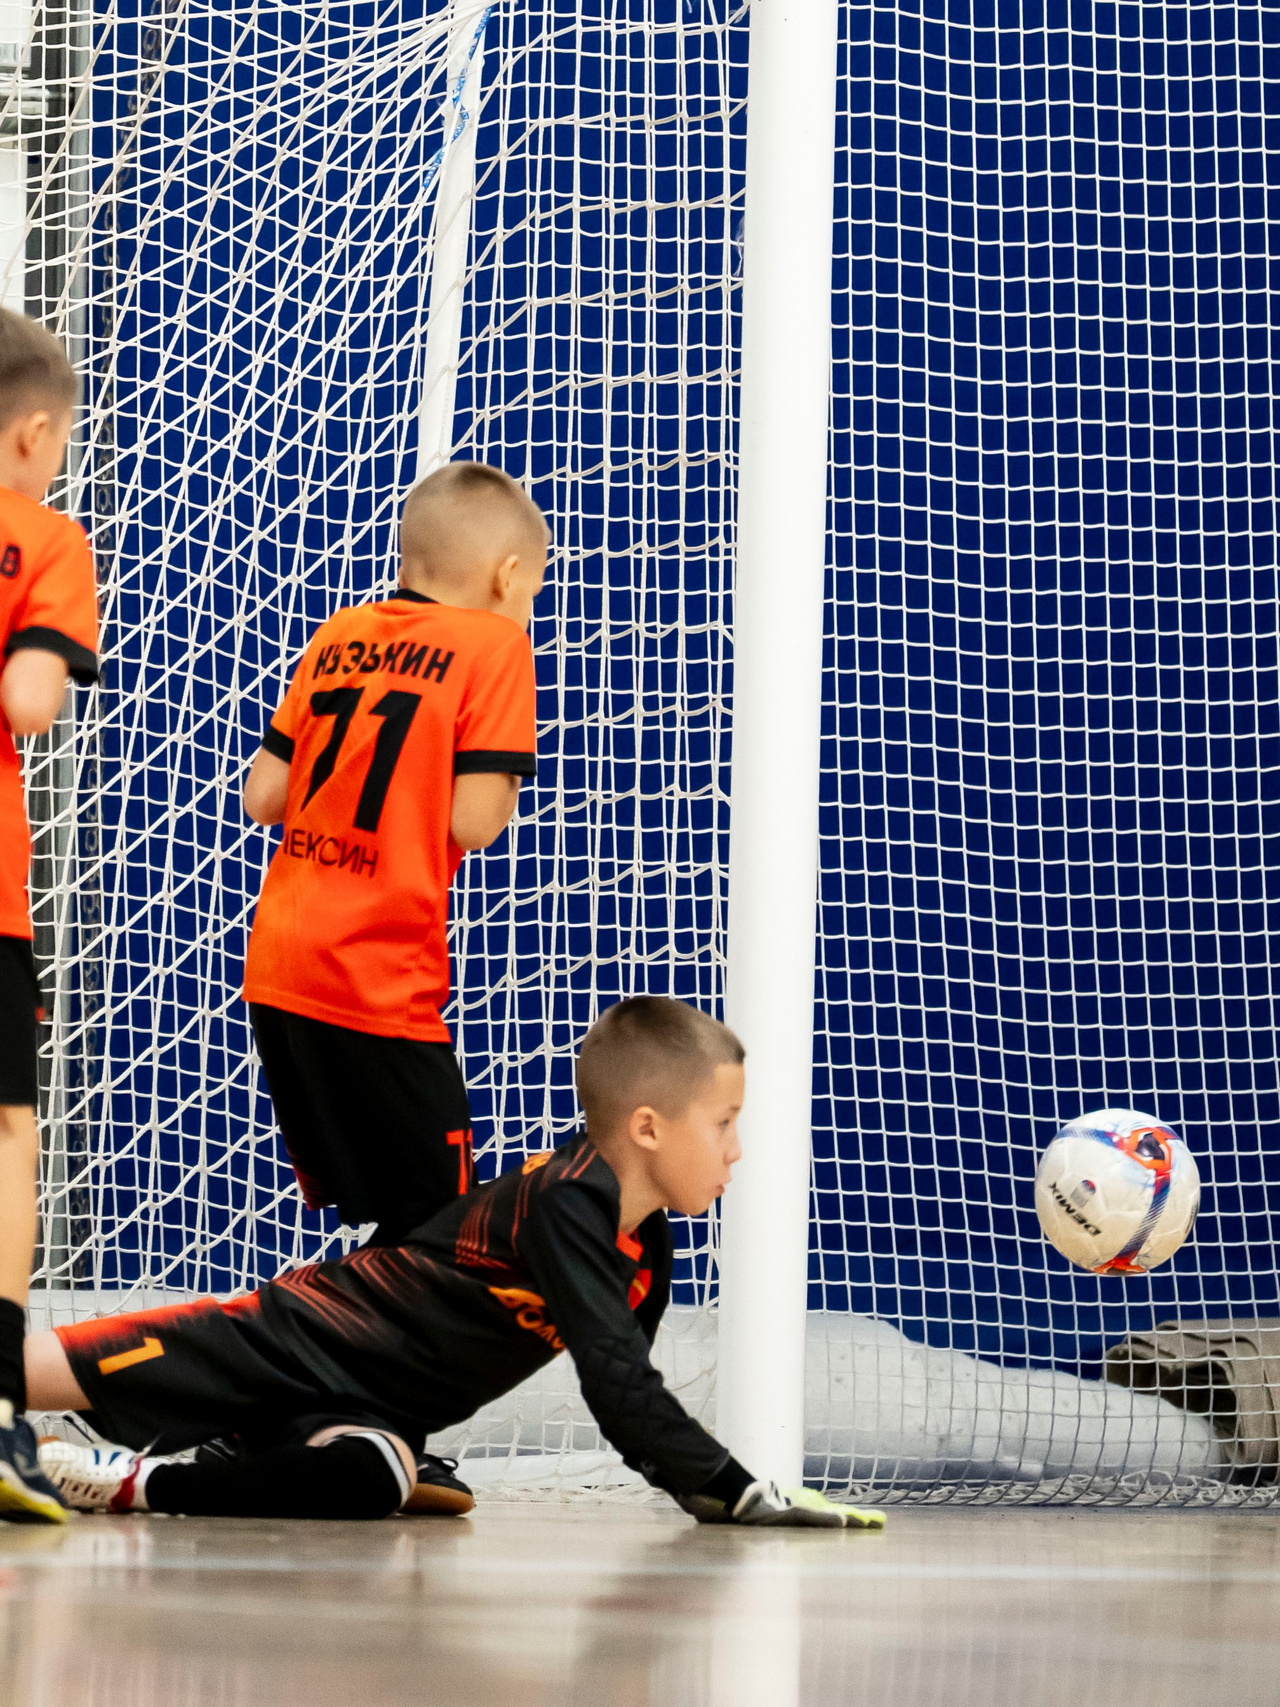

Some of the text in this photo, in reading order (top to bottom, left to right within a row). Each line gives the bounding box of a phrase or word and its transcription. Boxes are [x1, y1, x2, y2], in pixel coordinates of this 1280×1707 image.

[300, 686, 423, 834] 71
[1048, 1181, 1102, 1238] DEMIX
[97, 1336, 166, 1376] 1
